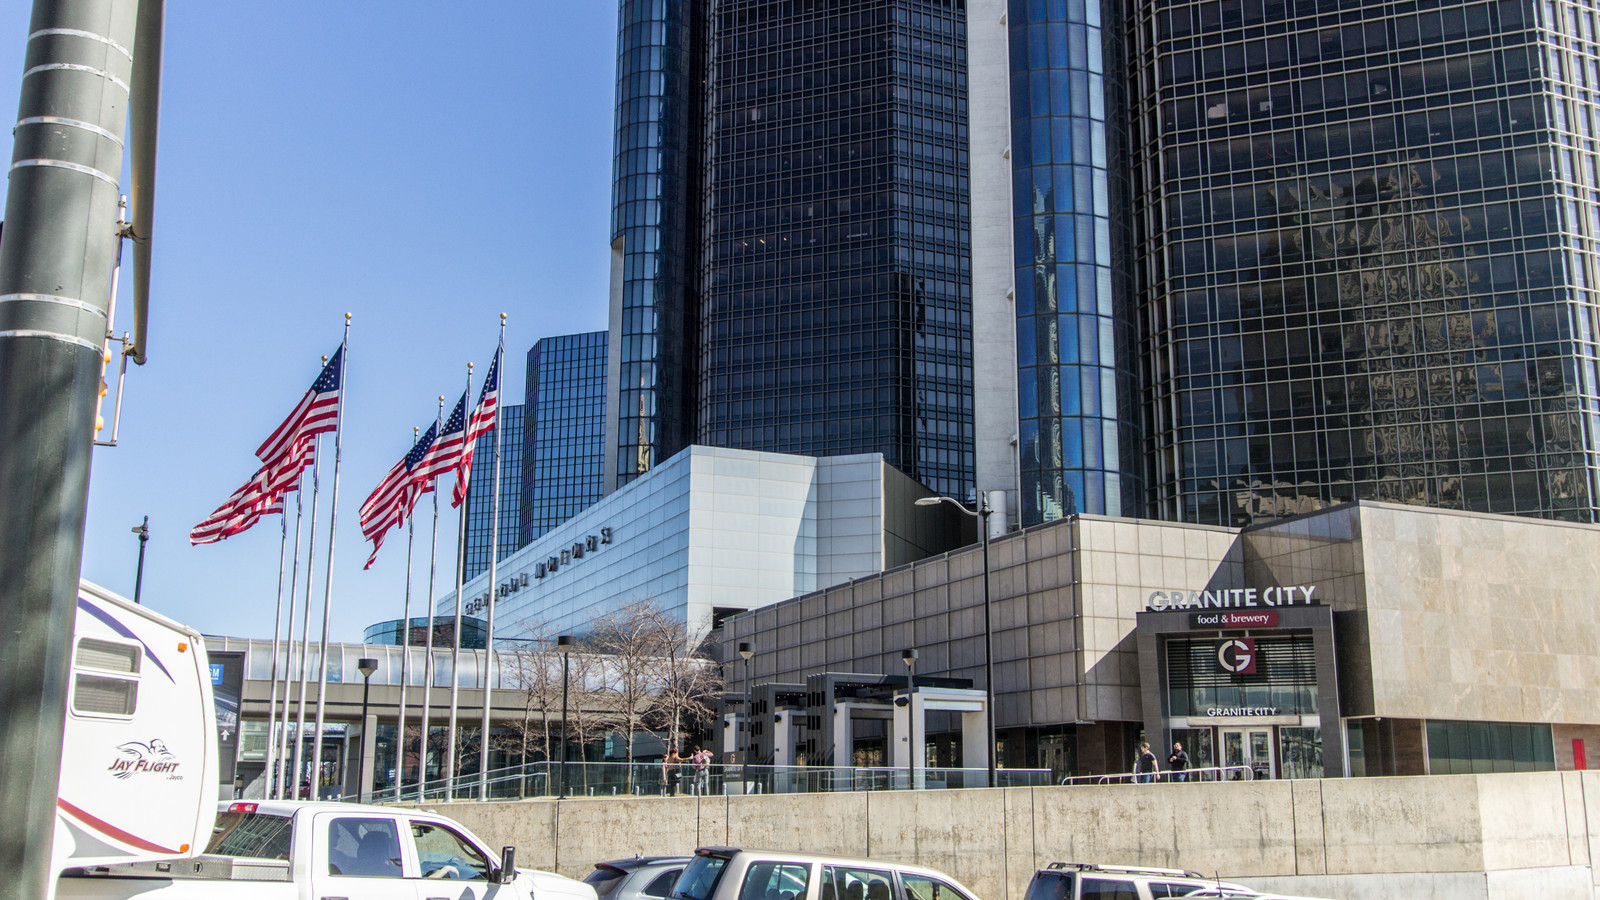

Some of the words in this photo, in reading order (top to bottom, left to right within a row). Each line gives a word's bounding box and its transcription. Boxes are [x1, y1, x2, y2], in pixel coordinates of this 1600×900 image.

[465, 572, 528, 615] GENRAL
[1149, 588, 1257, 612] GRANITE
[1263, 585, 1316, 606] CITY
[1197, 614, 1218, 624] food
[1221, 614, 1229, 623] &
[1231, 613, 1270, 625] brewery
[1218, 639, 1251, 672] G
[1207, 707, 1253, 717] GRANITE
[1254, 707, 1277, 716] CITY
[107, 758, 135, 771] JAY
[134, 759, 180, 773] FLIGHT
